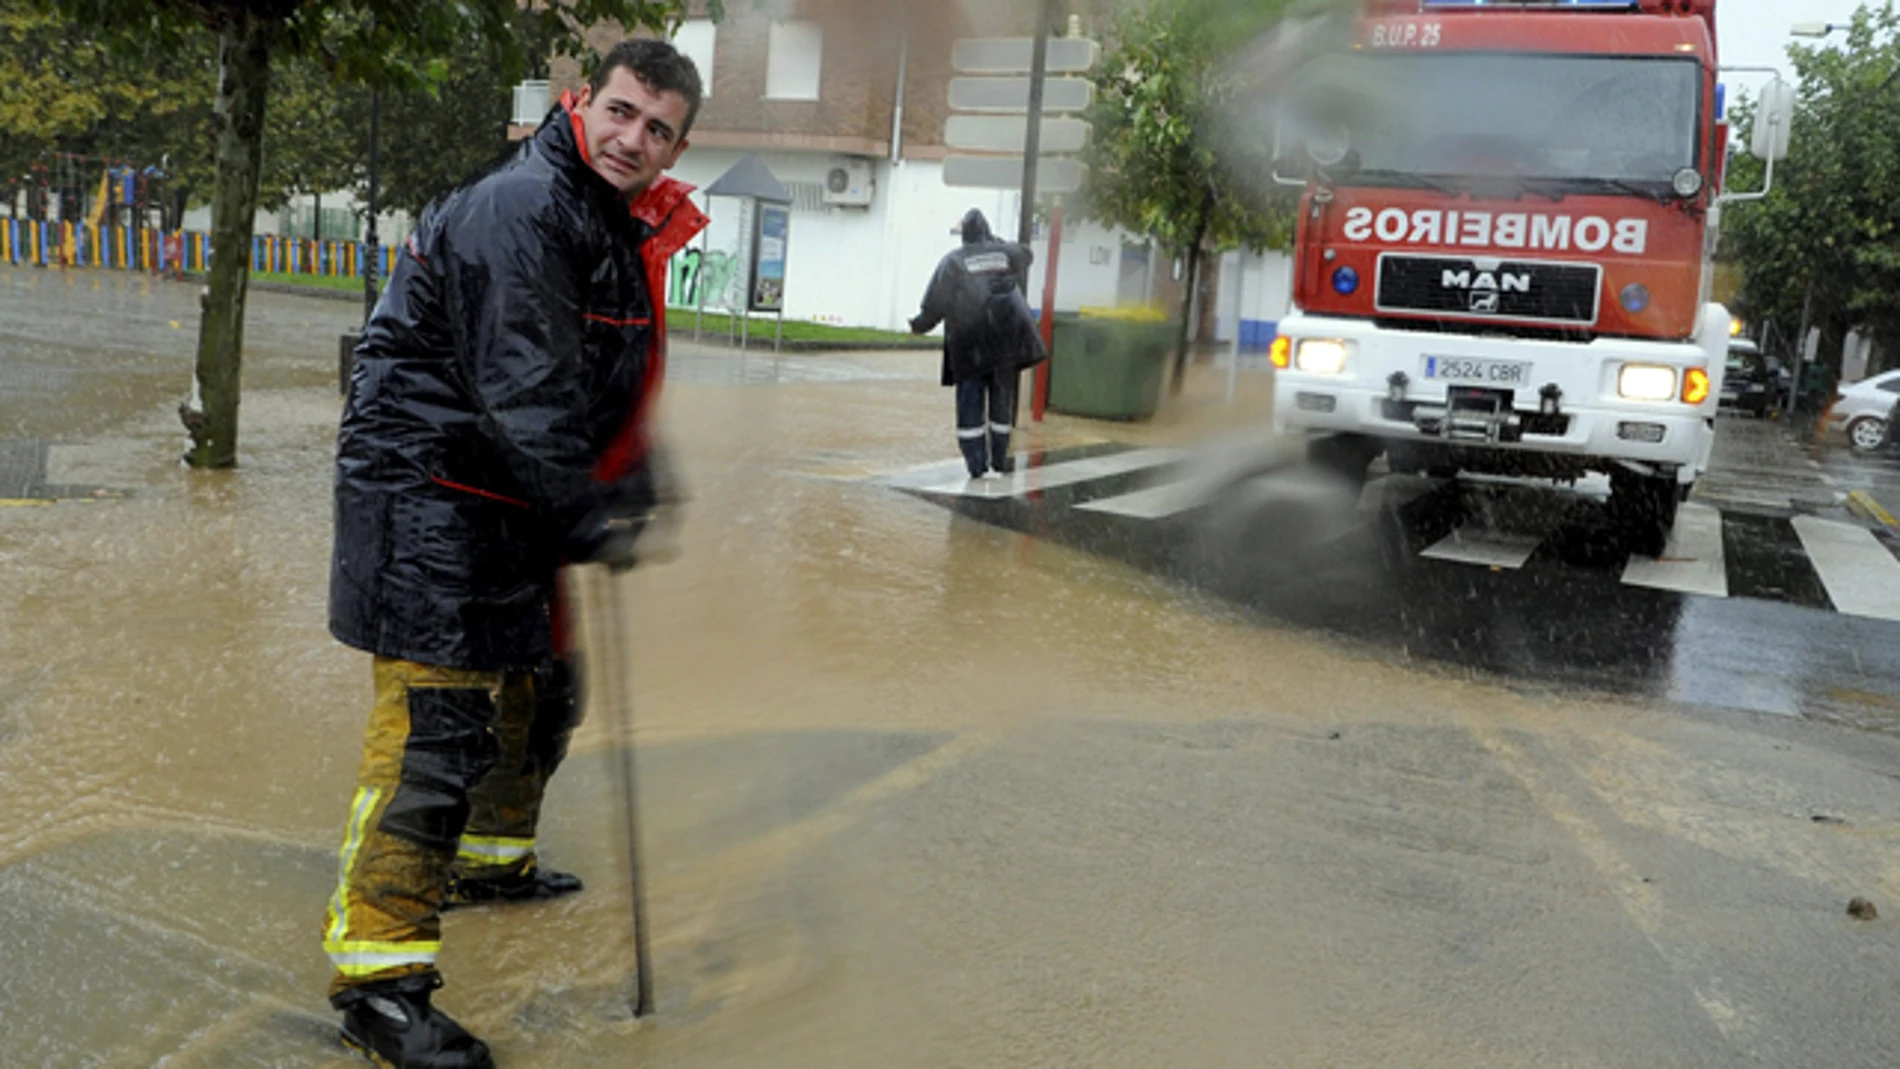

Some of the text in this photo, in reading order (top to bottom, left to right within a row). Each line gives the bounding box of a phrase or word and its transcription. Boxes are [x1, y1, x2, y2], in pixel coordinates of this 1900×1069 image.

[1421, 23, 1441, 47] 25
[1441, 269, 1530, 292] MAN
[1441, 360, 1483, 379] 2524
